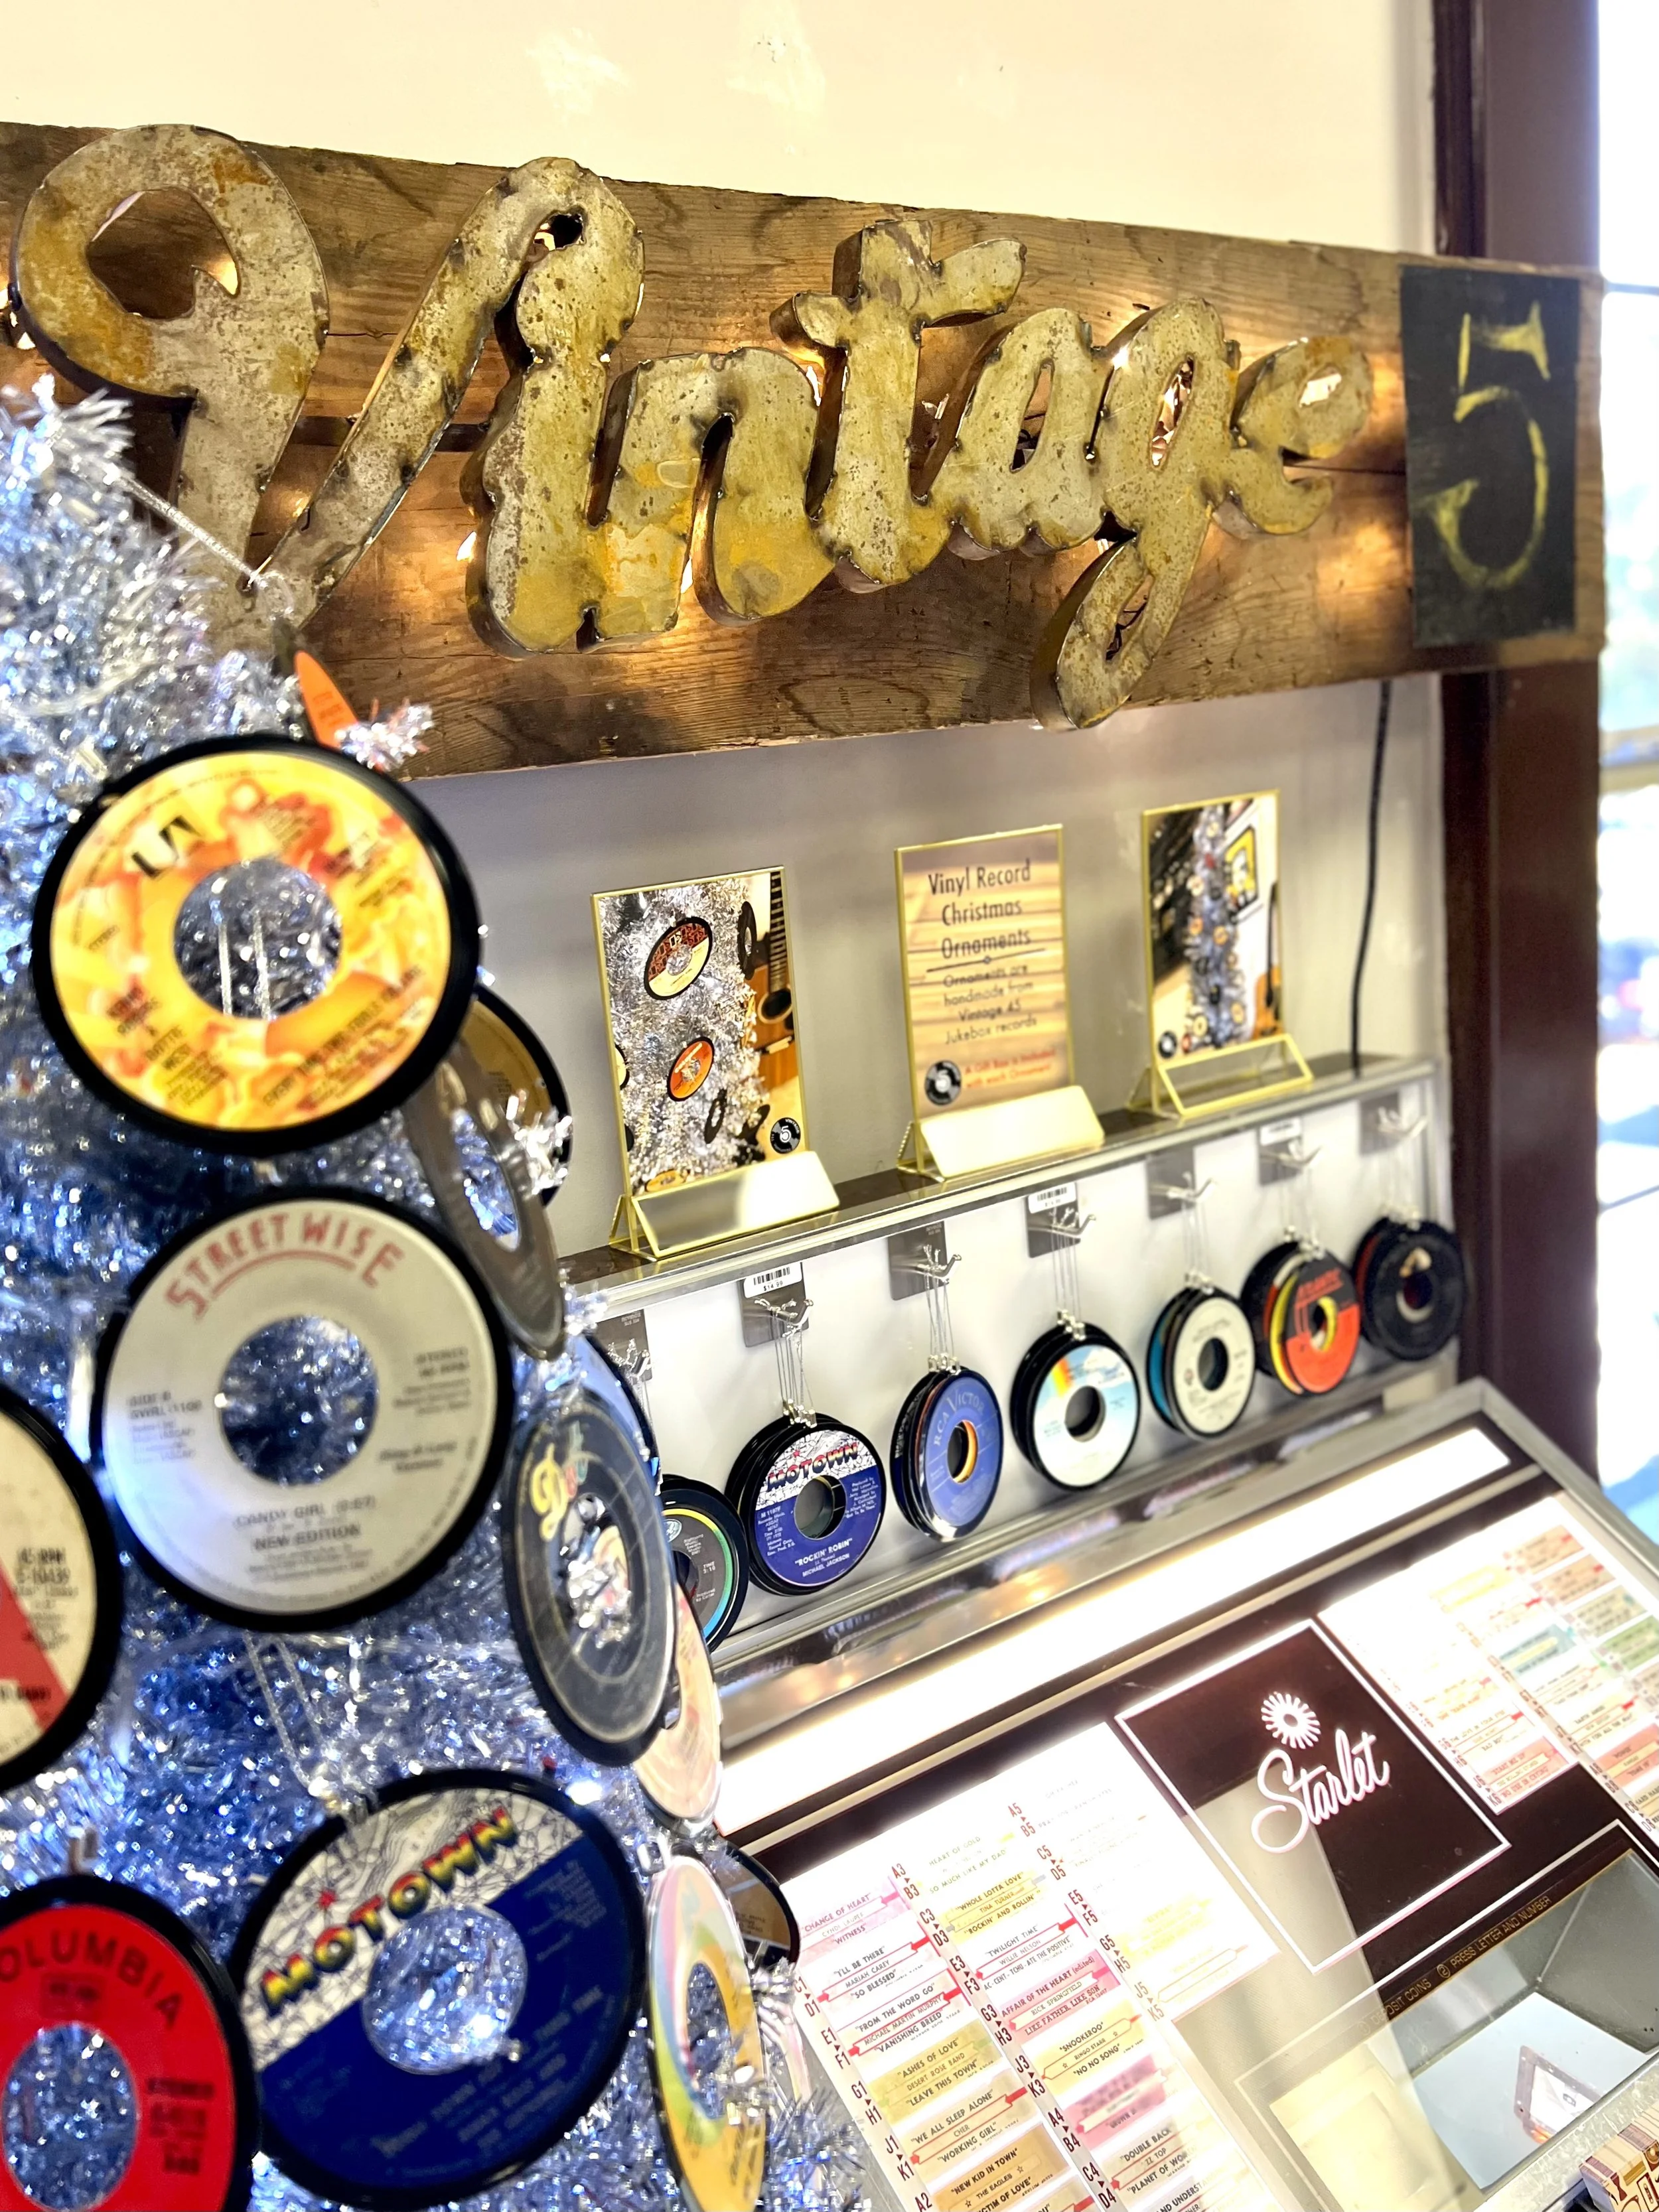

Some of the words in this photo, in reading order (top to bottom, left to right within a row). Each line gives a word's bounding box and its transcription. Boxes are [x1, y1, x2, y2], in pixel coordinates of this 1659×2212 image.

[10, 124, 1371, 728] Vintage
[1427, 300, 1550, 589] 5
[928, 867, 970, 896] Vinyl
[977, 859, 1031, 886] Record
[942, 900, 1021, 926] Christmas
[942, 930, 1031, 959] Ornaments
[944, 968, 1006, 987] Ornaments
[1010, 964, 1028, 977] are
[944, 985, 1005, 1006] handmade
[1008, 981, 1033, 997] from
[958, 1004, 1003, 1022] Vintage
[1007, 1000, 1021, 1013] 45
[945, 1025, 991, 1045] Jukebox
[995, 1017, 1037, 1034] records
[766, 1442, 858, 1492] MOTOWN
[802, 1564, 825, 1578] MICHAEL
[826, 1554, 850, 1569] JACKSON
[1251, 1728, 1390, 1853] Starlet
[1008, 1802, 1023, 1817] A5
[1020, 1822, 1036, 1837] B5
[929, 1852, 950, 1866] HEART
[964, 1836, 981, 1848] GOLD
[1037, 1844, 1052, 1860] C5
[891, 1863, 906, 1879] A3
[930, 1886, 940, 1894] SO
[942, 1874, 961, 1887] MUCH
[963, 1865, 977, 1876] LIKE
[979, 1858, 989, 1868] MY
[1050, 1864, 1066, 1881] D5
[904, 1884, 920, 1900] B3
[956, 1895, 983, 1911] "WHOLE
[983, 1884, 1004, 1898] LOTTA
[1005, 1872, 1024, 1886] LOVE"
[1068, 1890, 1084, 1905] E5
[261, 1806, 518, 2017] MOTOWN
[835, 1907, 845, 1916] OF
[979, 1903, 993, 1914] TINA
[994, 1892, 1015, 1905] TURNER
[997, 1908, 1011, 1920] AND
[920, 1908, 935, 1924] C3
[1082, 1909, 1098, 1926] F5
[933, 1930, 949, 1946] D3
[1100, 1934, 1116, 1951] G5
[851, 1961, 861, 1970] BE
[862, 1946, 885, 1963] THERE"
[999, 1953, 1018, 1965] WILLIE
[1019, 1939, 1041, 1955] NELSON
[1036, 1949, 1047, 1959] THE
[1370, 1996, 1407, 2024] DEPOSIT
[1404, 1978, 1431, 2002] COINS
[1451, 1947, 1477, 1969] PRESS
[1477, 1927, 1503, 1951] LETTER
[1502, 1917, 1520, 1934] AND
[1518, 1896, 1552, 1923] NUMBER
[845, 1972, 870, 1989] MARIAH
[871, 1959, 890, 1973] CAREY
[950, 1955, 966, 1972] E3
[1114, 1956, 1131, 1974] H5
[850, 1989, 866, 2000] "SO
[867, 1969, 897, 1992] BLESSED"
[964, 1977, 980, 1995] F3
[1001, 1998, 1027, 2017] AFFAIR
[1027, 1991, 1035, 2002] OF
[1035, 1983, 1048, 1996] THE
[1048, 1970, 1072, 1988] HEART
[1072, 1957, 1095, 1976] (edited)
[1134, 1981, 1149, 1998] J5
[804, 1999, 820, 2017] D1
[855, 2016, 881, 2032] "FROM
[882, 2007, 897, 2019] THE
[897, 1994, 920, 2010] WORD
[922, 1982, 935, 1995] GO"
[1031, 2004, 1046, 2016] RICK
[1046, 1981, 1082, 2006] SPRINGFIELD
[864, 2027, 891, 2046] MICHAEL
[892, 2012, 916, 2030] MARTIN
[918, 1996, 943, 2014] MURPHY
[980, 2004, 997, 2022] G3
[1025, 2022, 1043, 2036] LIKE
[1070, 1994, 1087, 2008] LIKE
[1087, 1984, 1100, 1996] SON
[1147, 2004, 1165, 2022] K5
[821, 2026, 837, 2045] E1
[874, 2026, 919, 2053] "VANISHING
[920, 2008, 943, 2028] BREED"
[995, 2027, 1013, 2046] H3
[1060, 2022, 1104, 2052] "SNOOKEROO"
[835, 2051, 851, 2069] F1
[897, 2059, 925, 2077] "ASHES
[926, 2052, 936, 2063] OF
[938, 2037, 959, 2055] LOVE"
[1073, 2065, 1088, 2077] "NO
[1088, 2057, 1100, 2069] NO
[1100, 2043, 1120, 2061] SONG"
[1074, 2048, 1090, 2060] RINGO
[1091, 2038, 1106, 2051] STARR
[906, 2075, 928, 2091] DESERT
[930, 2063, 947, 2077] ROSE
[948, 2052, 966, 2066] BAND
[1015, 2055, 1030, 2073] J3
[851, 2080, 867, 2099] G1
[906, 2086, 934, 2107] "LEAVE
[935, 2077, 952, 2091] THIS
[953, 2059, 978, 2079] TOWN"
[1028, 2079, 1046, 2098] K3
[865, 2105, 882, 2125] H1
[911, 2132, 928, 2144] "WE
[930, 2124, 945, 2137] ALL
[946, 2108, 966, 2126] SLEEP
[968, 2089, 993, 2112] ALONE"
[1048, 2107, 1064, 2127] A4
[937, 2136, 978, 2162] "WORKING
[979, 2121, 997, 2138] GIRL"
[954, 2124, 970, 2138] CHER
[1062, 2132, 1081, 2152] B4
[885, 2134, 899, 2154] J1
[1120, 2140, 1151, 2162] "DOUBLE
[1155, 2148, 1167, 2159] TOP
[897, 2160, 915, 2181] K1
[951, 2179, 971, 2195] "NEW
[973, 2171, 985, 2183] KID
[987, 2165, 995, 2174] IN
[995, 2148, 1018, 2168] TOWN"
[1082, 2162, 1100, 2181] C4
[1127, 2173, 1158, 2194] "PLANET
[1159, 2164, 1169, 2175] OF
[976, 2189, 989, 2200] THE
[989, 2174, 1013, 2191] EAGLES
[1000, 2191, 1010, 2202] OF
[1011, 2176, 1031, 2195] LOVE"
[1098, 2187, 1117, 2209] D4
